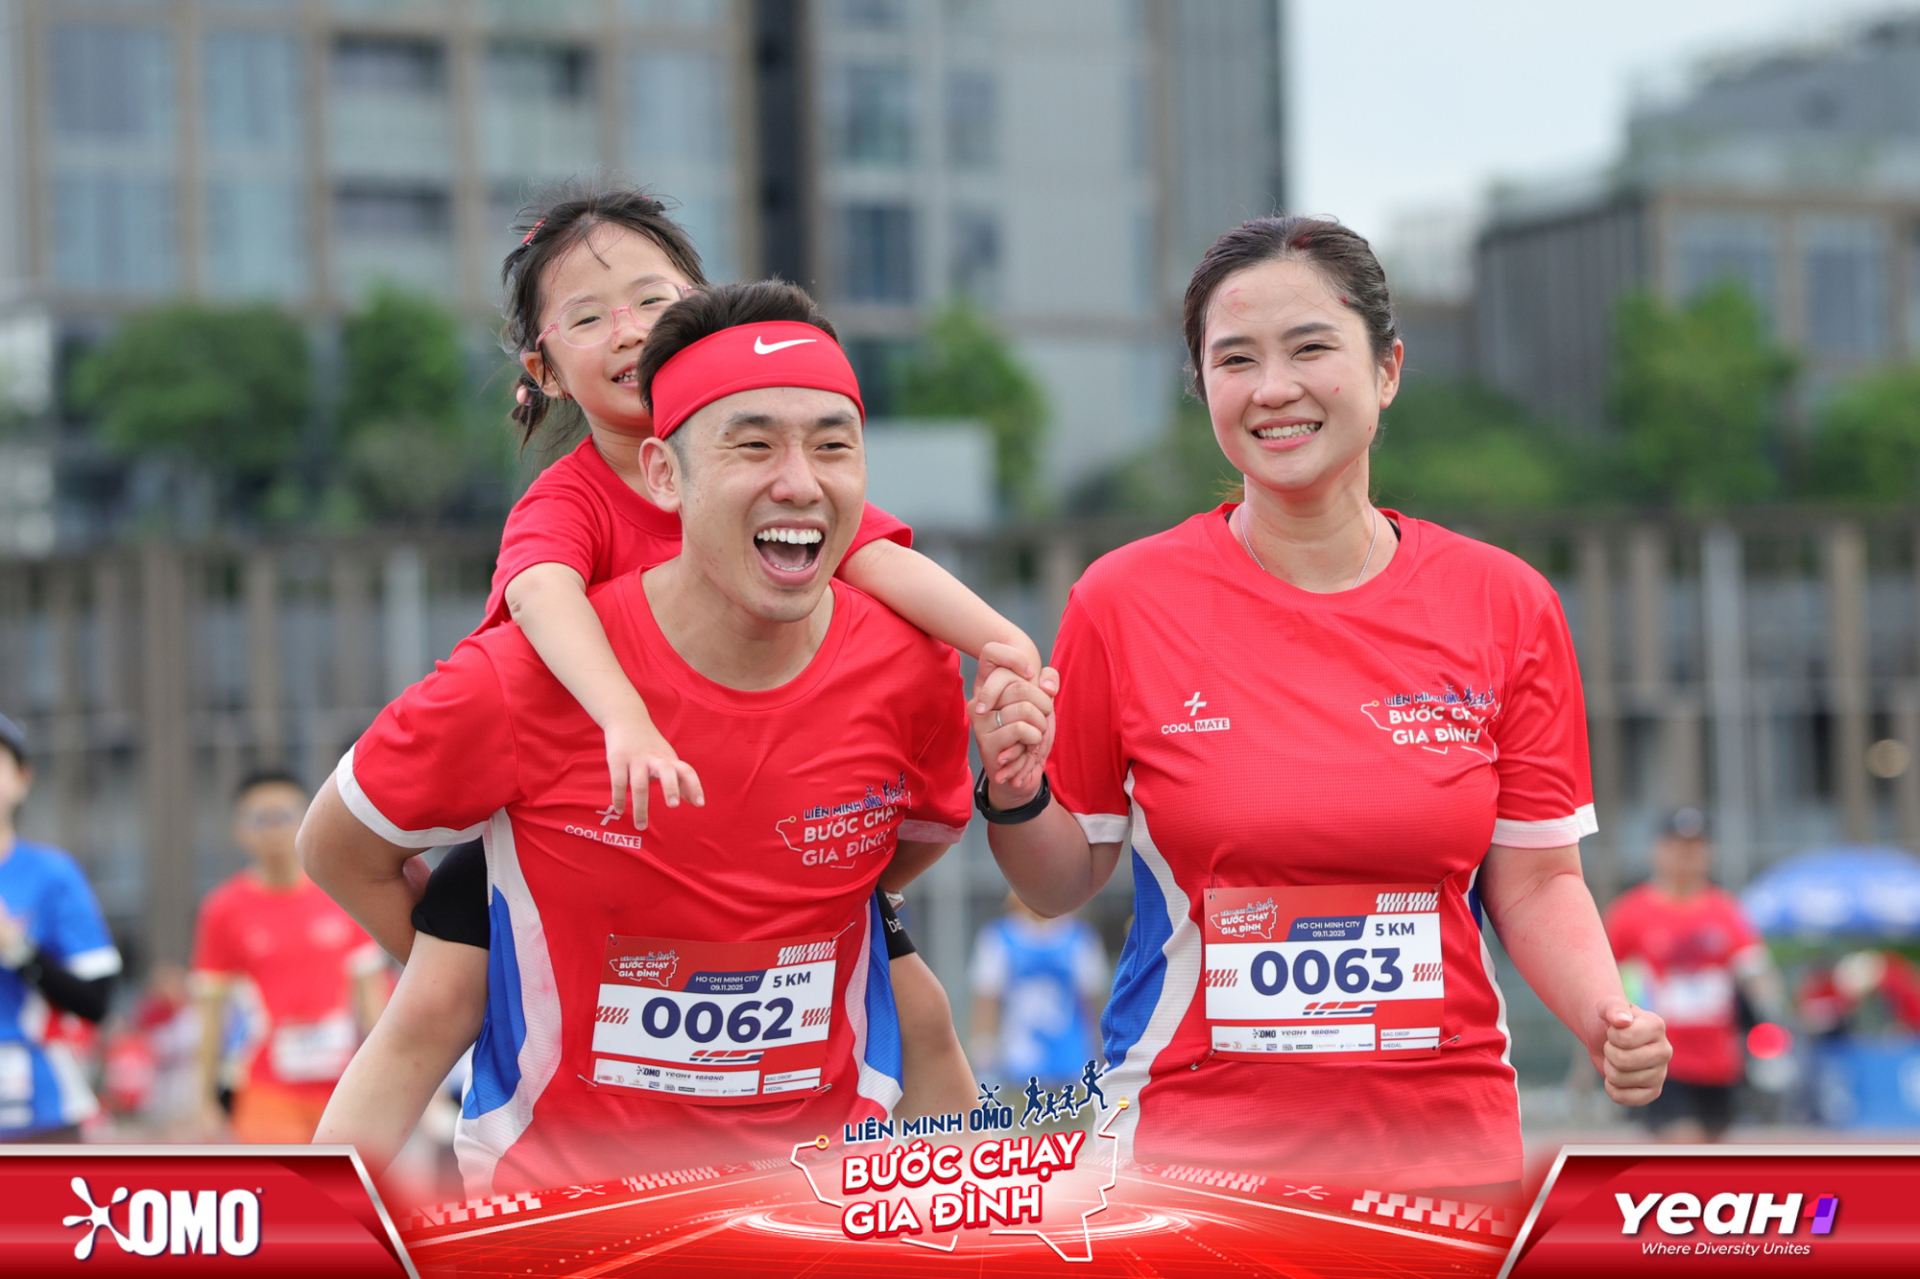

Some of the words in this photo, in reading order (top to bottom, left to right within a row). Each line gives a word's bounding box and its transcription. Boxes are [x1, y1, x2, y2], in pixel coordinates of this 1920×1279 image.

[1389, 704, 1445, 724] BƯỚC
[1392, 728, 1430, 745] GIA
[1435, 723, 1480, 743] ĐÌNH
[804, 805, 831, 820] LIÊN
[833, 801, 862, 816] MINH
[863, 796, 883, 809] OMO
[804, 817, 858, 842] BƯỚC
[802, 847, 839, 866] GIA
[1246, 912, 1269, 922] CHẠY
[1221, 927, 1237, 935] GIA
[1239, 922, 1262, 933] ĐÌNH
[1297, 922, 1309, 930] HO
[1310, 922, 1323, 930] CHI
[1324, 921, 1344, 929] MINH
[1345, 920, 1361, 928] CITY
[1375, 923, 1385, 937] 5
[1388, 922, 1415, 937] KM
[1312, 930, 1346, 938] 09.11.2025
[636, 969, 660, 977] ĐÌNH
[696, 975, 708, 983] HO
[744, 975, 760, 983] CITY
[1250, 947, 1404, 996] 0063
[773, 975, 782, 988] 5
[785, 971, 811, 987] KM
[641, 997, 794, 1044] 0062
[1259, 1029, 1277, 1039] OMO
[643, 1067, 661, 1077] OMO
